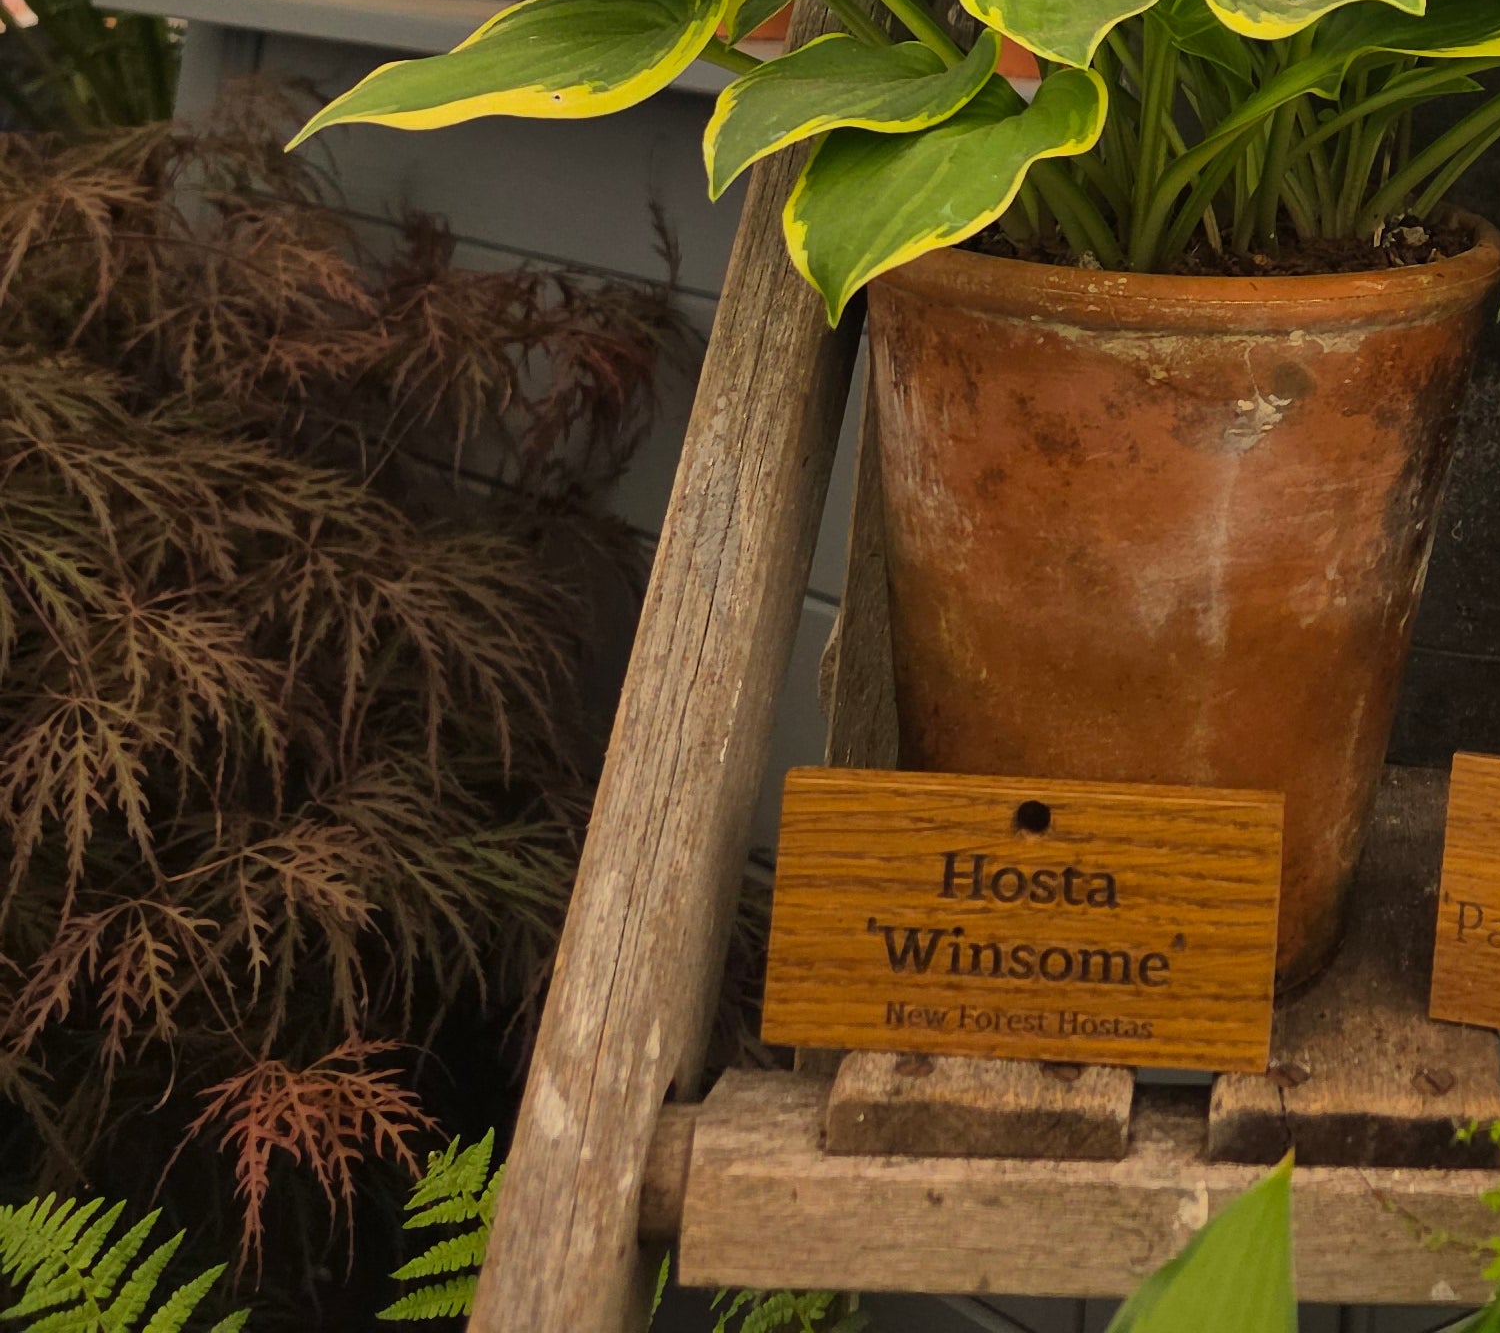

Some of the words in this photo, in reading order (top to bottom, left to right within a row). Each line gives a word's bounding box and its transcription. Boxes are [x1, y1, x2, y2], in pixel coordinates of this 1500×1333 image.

[937, 851, 1120, 910] Hosta
[866, 916, 1188, 988] 'Winsome'
[886, 1000, 948, 1030] New
[958, 1004, 1048, 1035] Forest
[1057, 1009, 1154, 1040] Hostas
